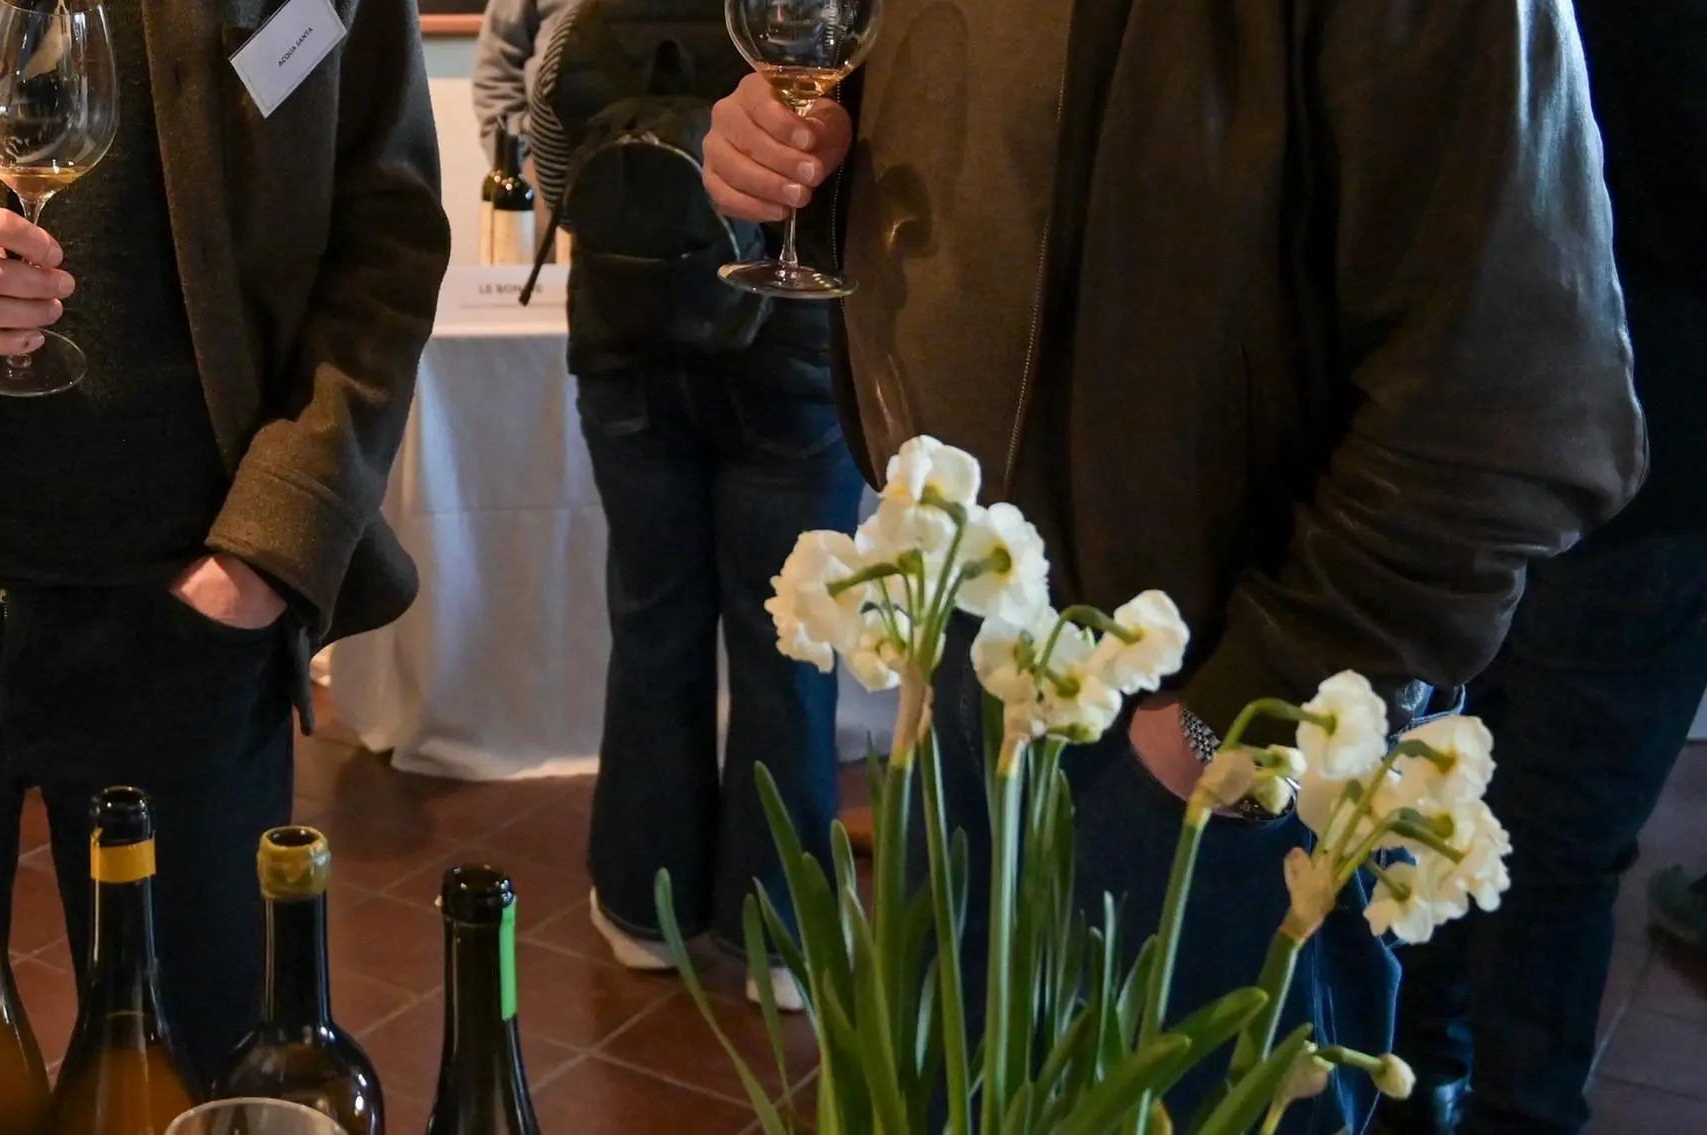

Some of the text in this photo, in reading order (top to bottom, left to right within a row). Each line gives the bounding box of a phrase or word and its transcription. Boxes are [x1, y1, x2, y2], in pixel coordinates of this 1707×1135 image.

[278, 27, 313, 67] ACQUA SANTA
[479, 284, 492, 294] LE
